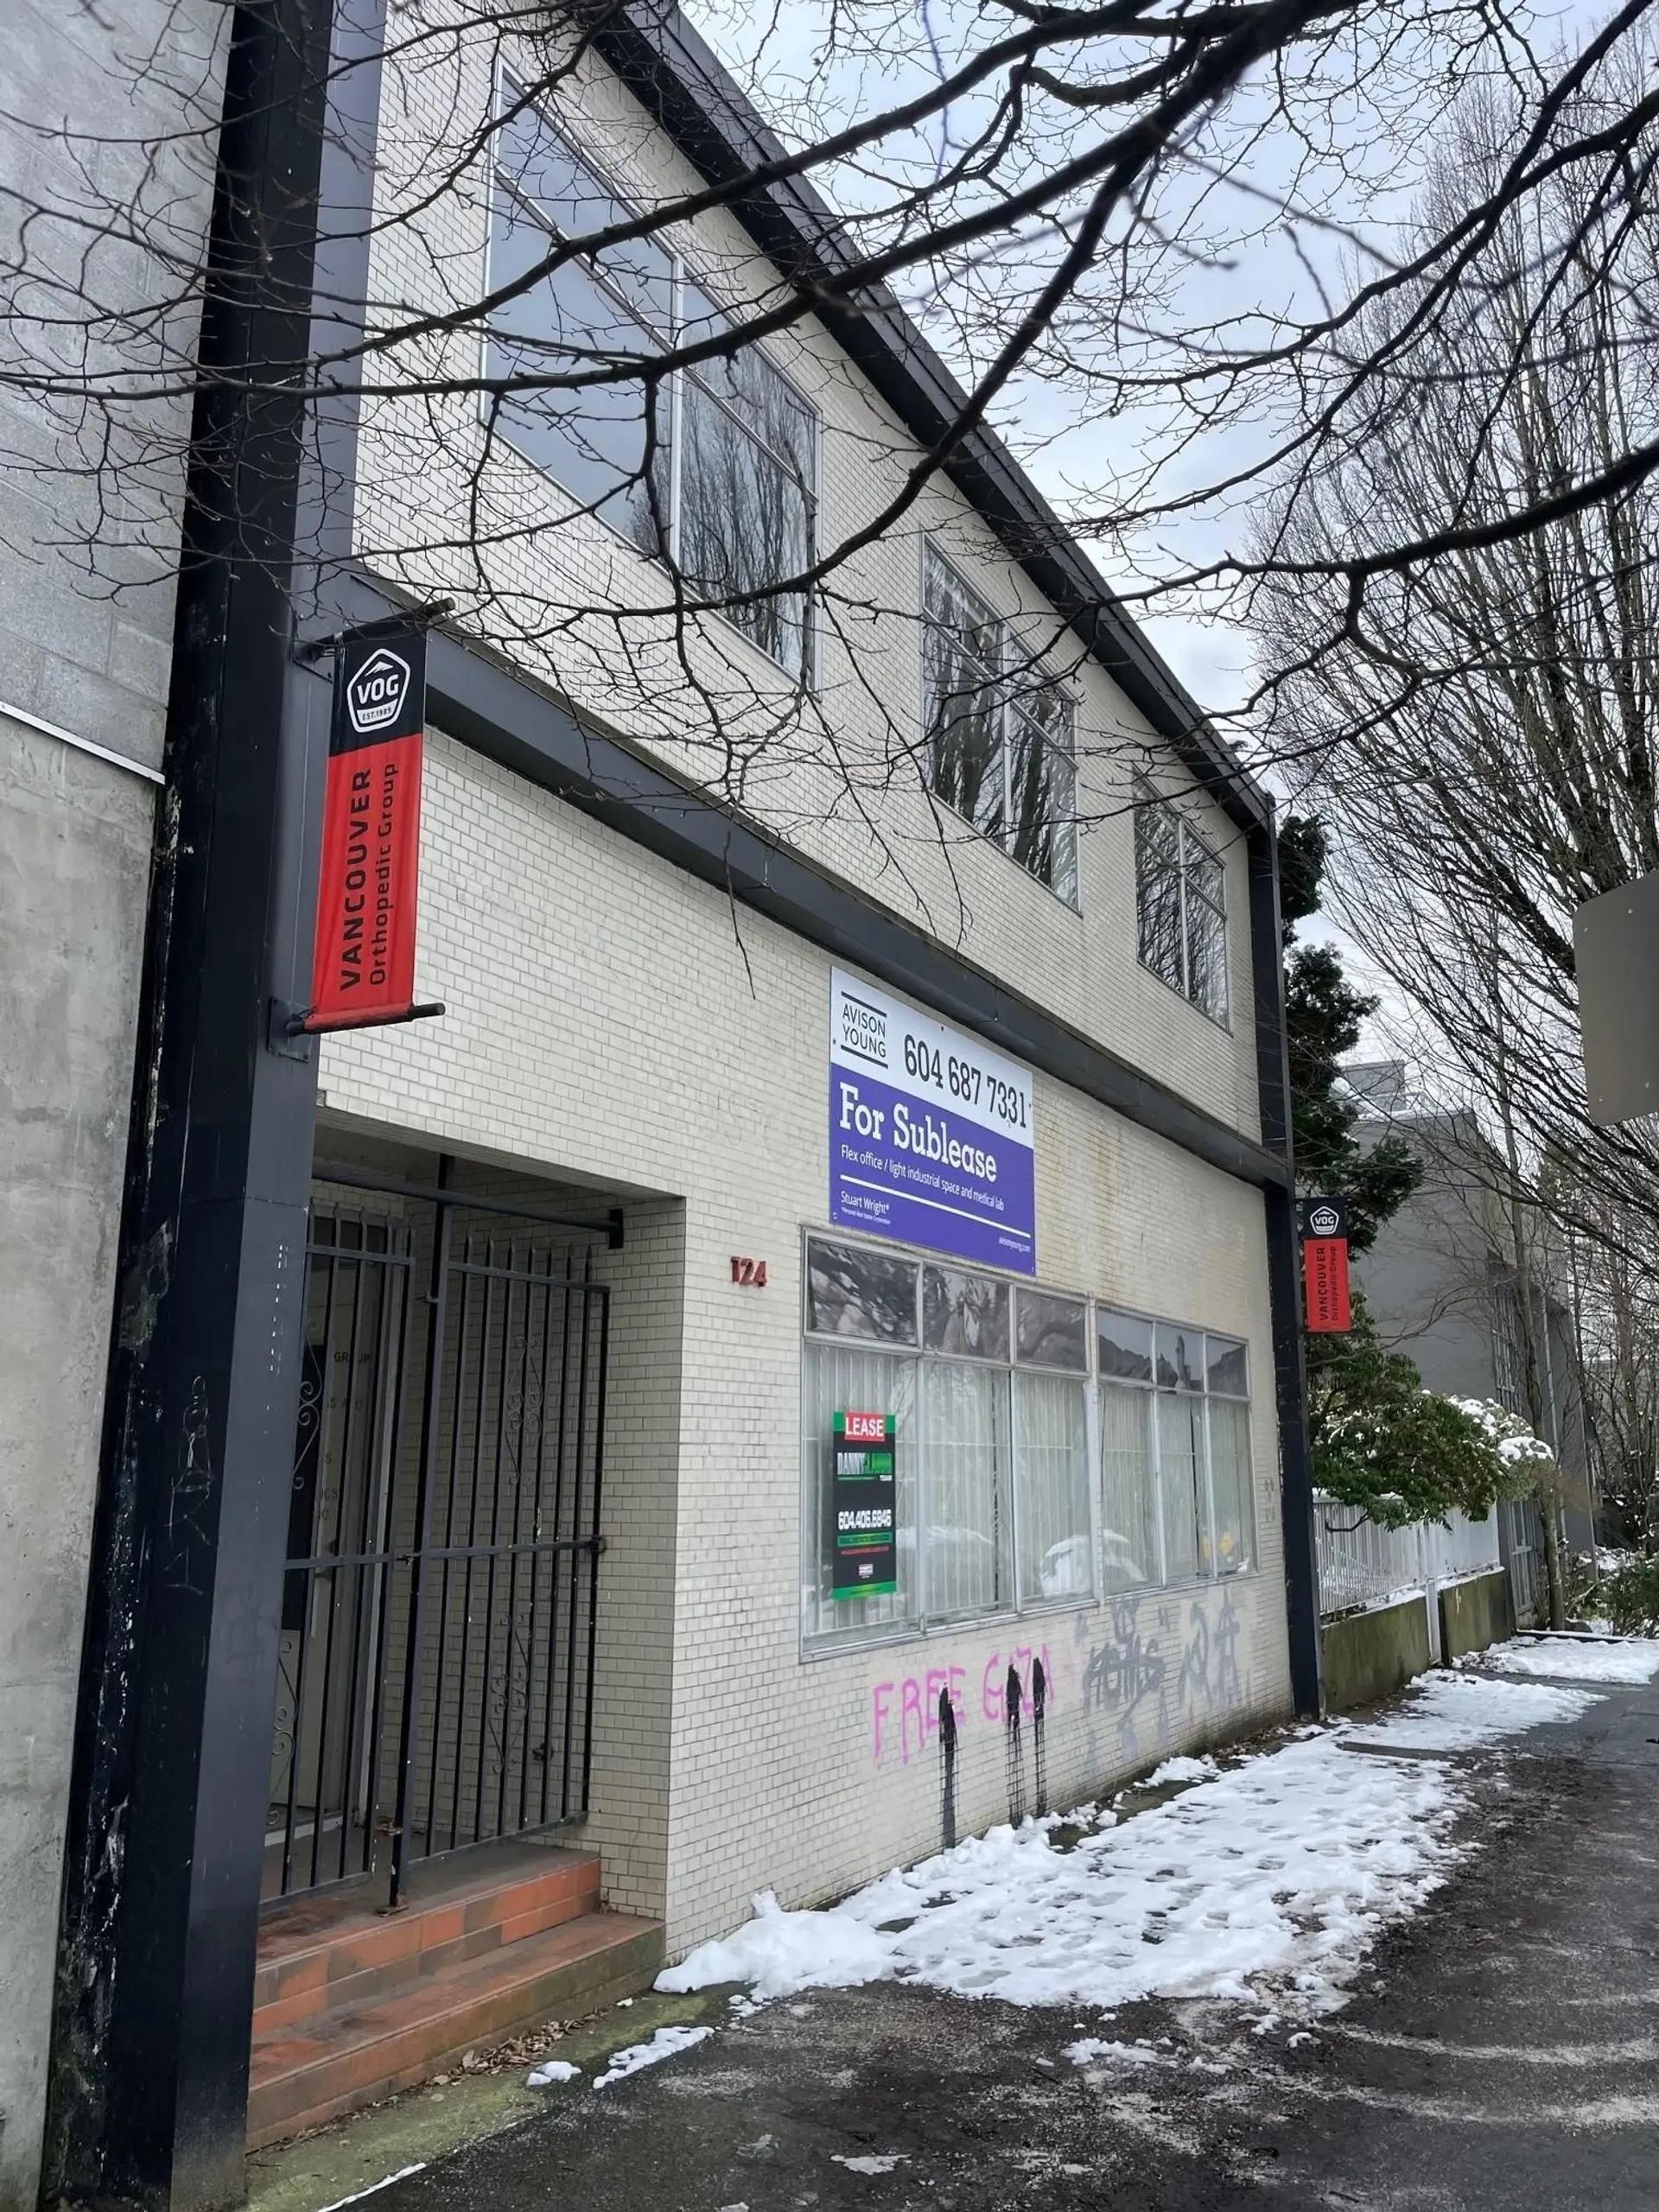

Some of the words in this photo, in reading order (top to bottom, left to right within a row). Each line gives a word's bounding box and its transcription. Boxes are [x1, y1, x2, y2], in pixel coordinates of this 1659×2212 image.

[357, 674, 399, 704] VOG
[377, 763, 399, 837] Group
[340, 766, 372, 993] VANCOUVER
[369, 843, 395, 986] Orthopedic
[842, 1003, 886, 1038] AVISON
[842, 1023, 886, 1058] YOUNG
[904, 1034, 943, 1089] 604
[948, 1056, 982, 1106] 687
[987, 1077, 1027, 1128] 7331
[840, 1082, 886, 1141] For
[893, 1102, 997, 1183] Sublease
[840, 1190, 862, 1208] Stuart
[842, 1144, 858, 1162] Flex
[860, 1151, 882, 1170] office
[883, 1159, 888, 1171] /
[889, 1159, 906, 1178] light
[907, 1165, 941, 1188] industrial
[941, 1179, 960, 1194] space
[961, 1186, 973, 1199] and
[973, 1191, 995, 1207] medical
[995, 1197, 1004, 1211] lab
[1314, 1216, 1335, 1226] VOG
[730, 1256, 767, 1287] 124
[1317, 1247, 1328, 1321] VANCOUVER
[844, 1417, 885, 1438] LEASE
[873, 1665, 967, 1765] FREE
